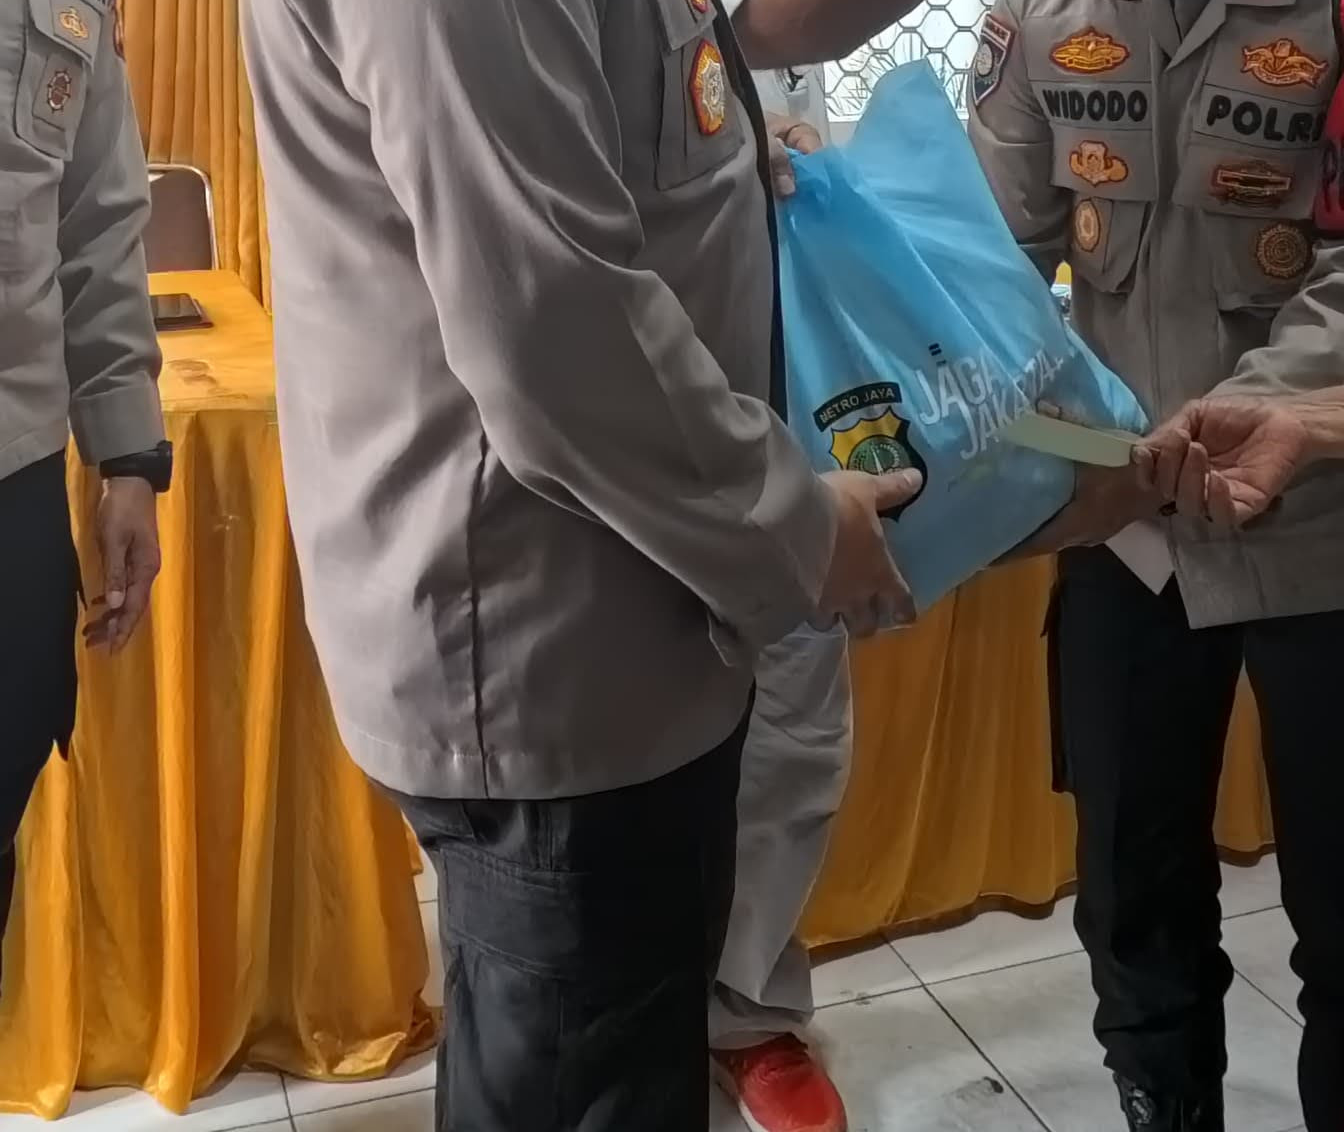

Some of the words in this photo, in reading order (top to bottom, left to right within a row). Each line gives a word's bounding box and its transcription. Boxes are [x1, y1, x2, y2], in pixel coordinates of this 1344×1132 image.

[1042, 89, 1148, 123] WIDODO
[819, 394, 859, 424] METRO
[863, 386, 895, 403] JAYA
[915, 348, 1003, 425] JAGA
